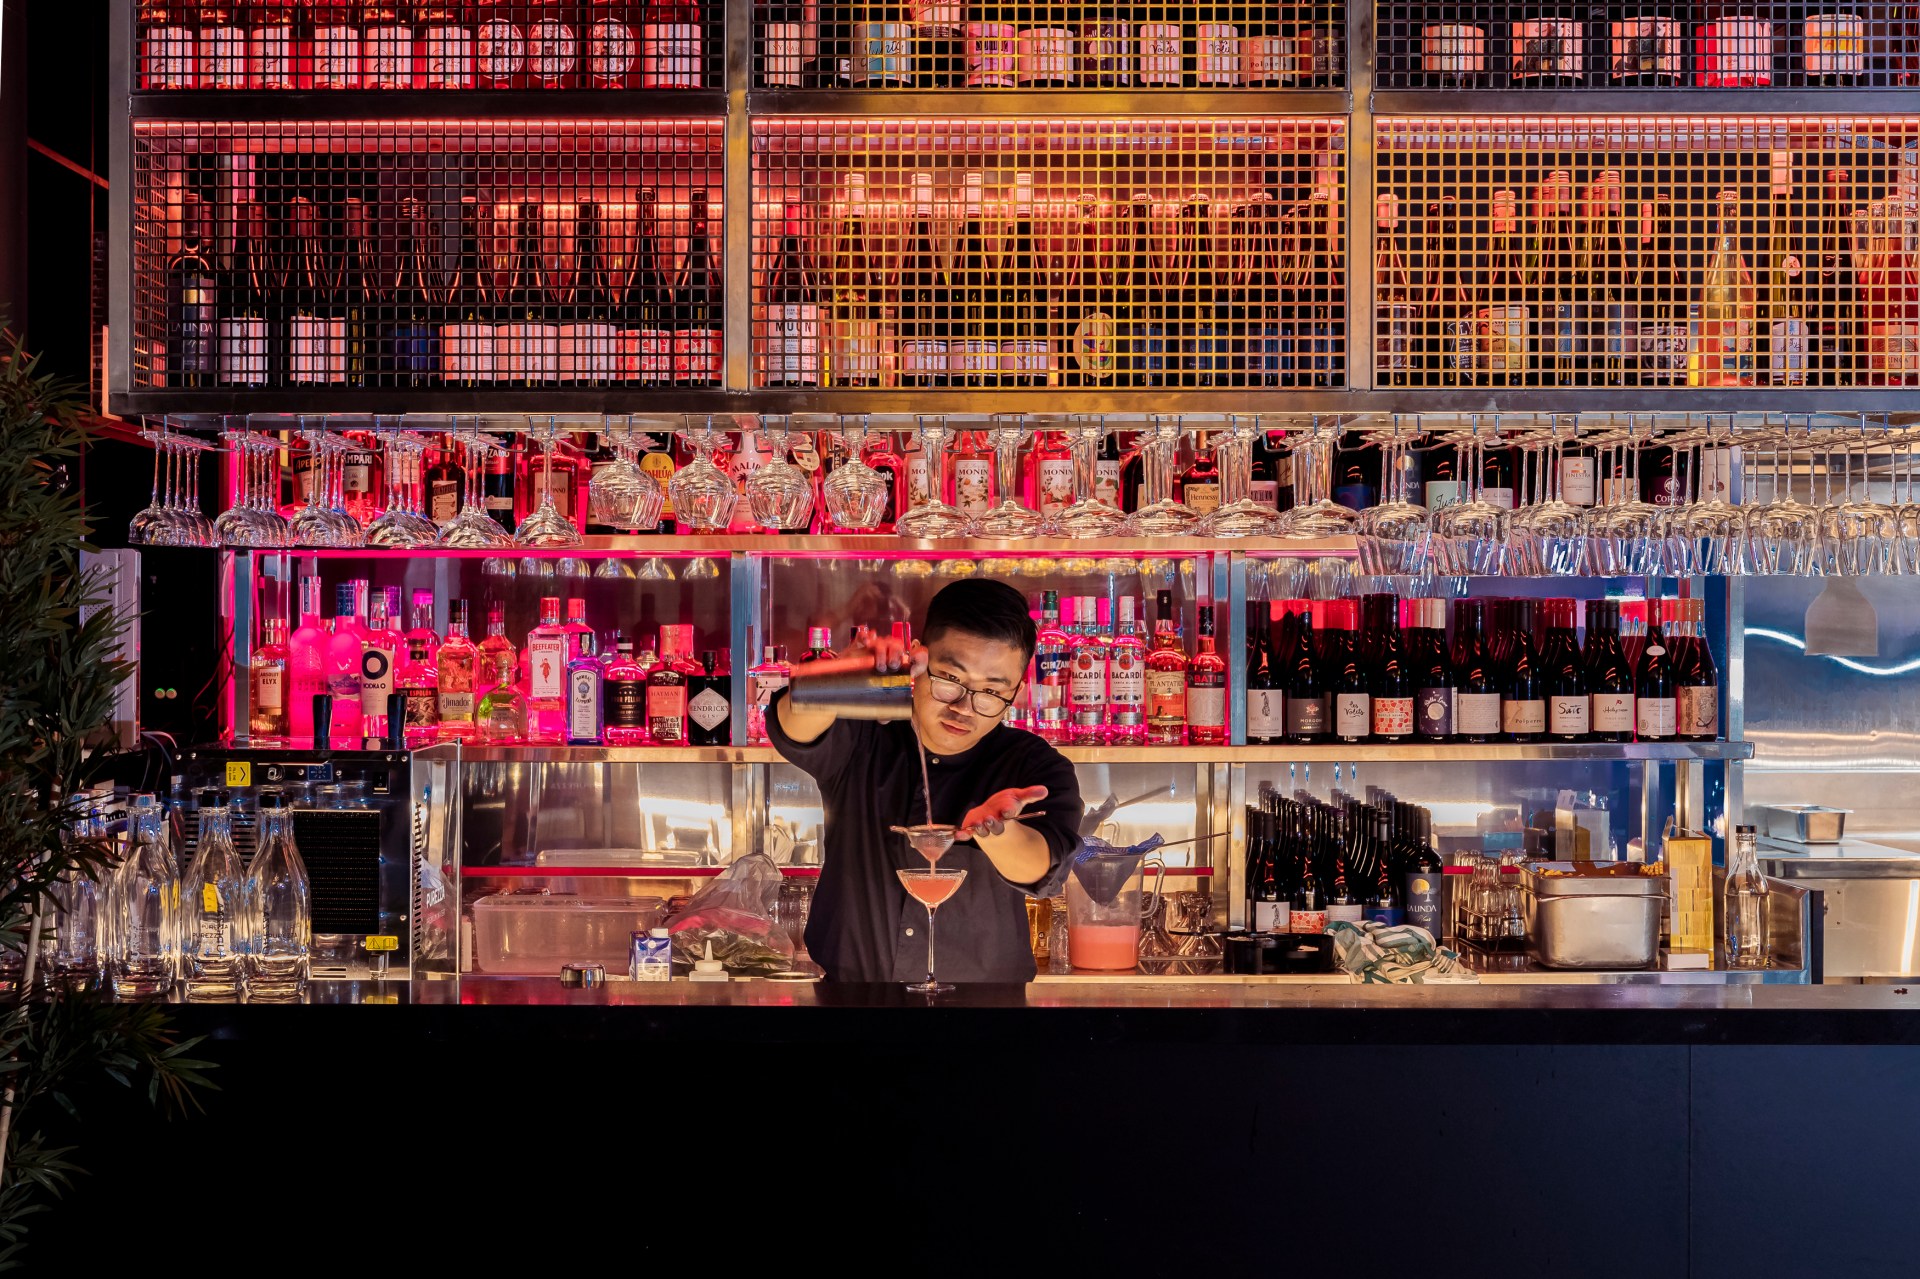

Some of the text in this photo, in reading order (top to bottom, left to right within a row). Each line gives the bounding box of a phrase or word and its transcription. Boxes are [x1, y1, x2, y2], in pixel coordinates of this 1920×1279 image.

[1190, 494, 1218, 502] Hennessy
[532, 643, 561, 652] BEEFEATER
[1072, 669, 1102, 680] BACARDÍ
[1111, 669, 1142, 680] BACARDÍ
[1194, 673, 1217, 684] BATI
[262, 677, 278, 685] ELYX
[1414, 904, 1438, 913] LINDA
